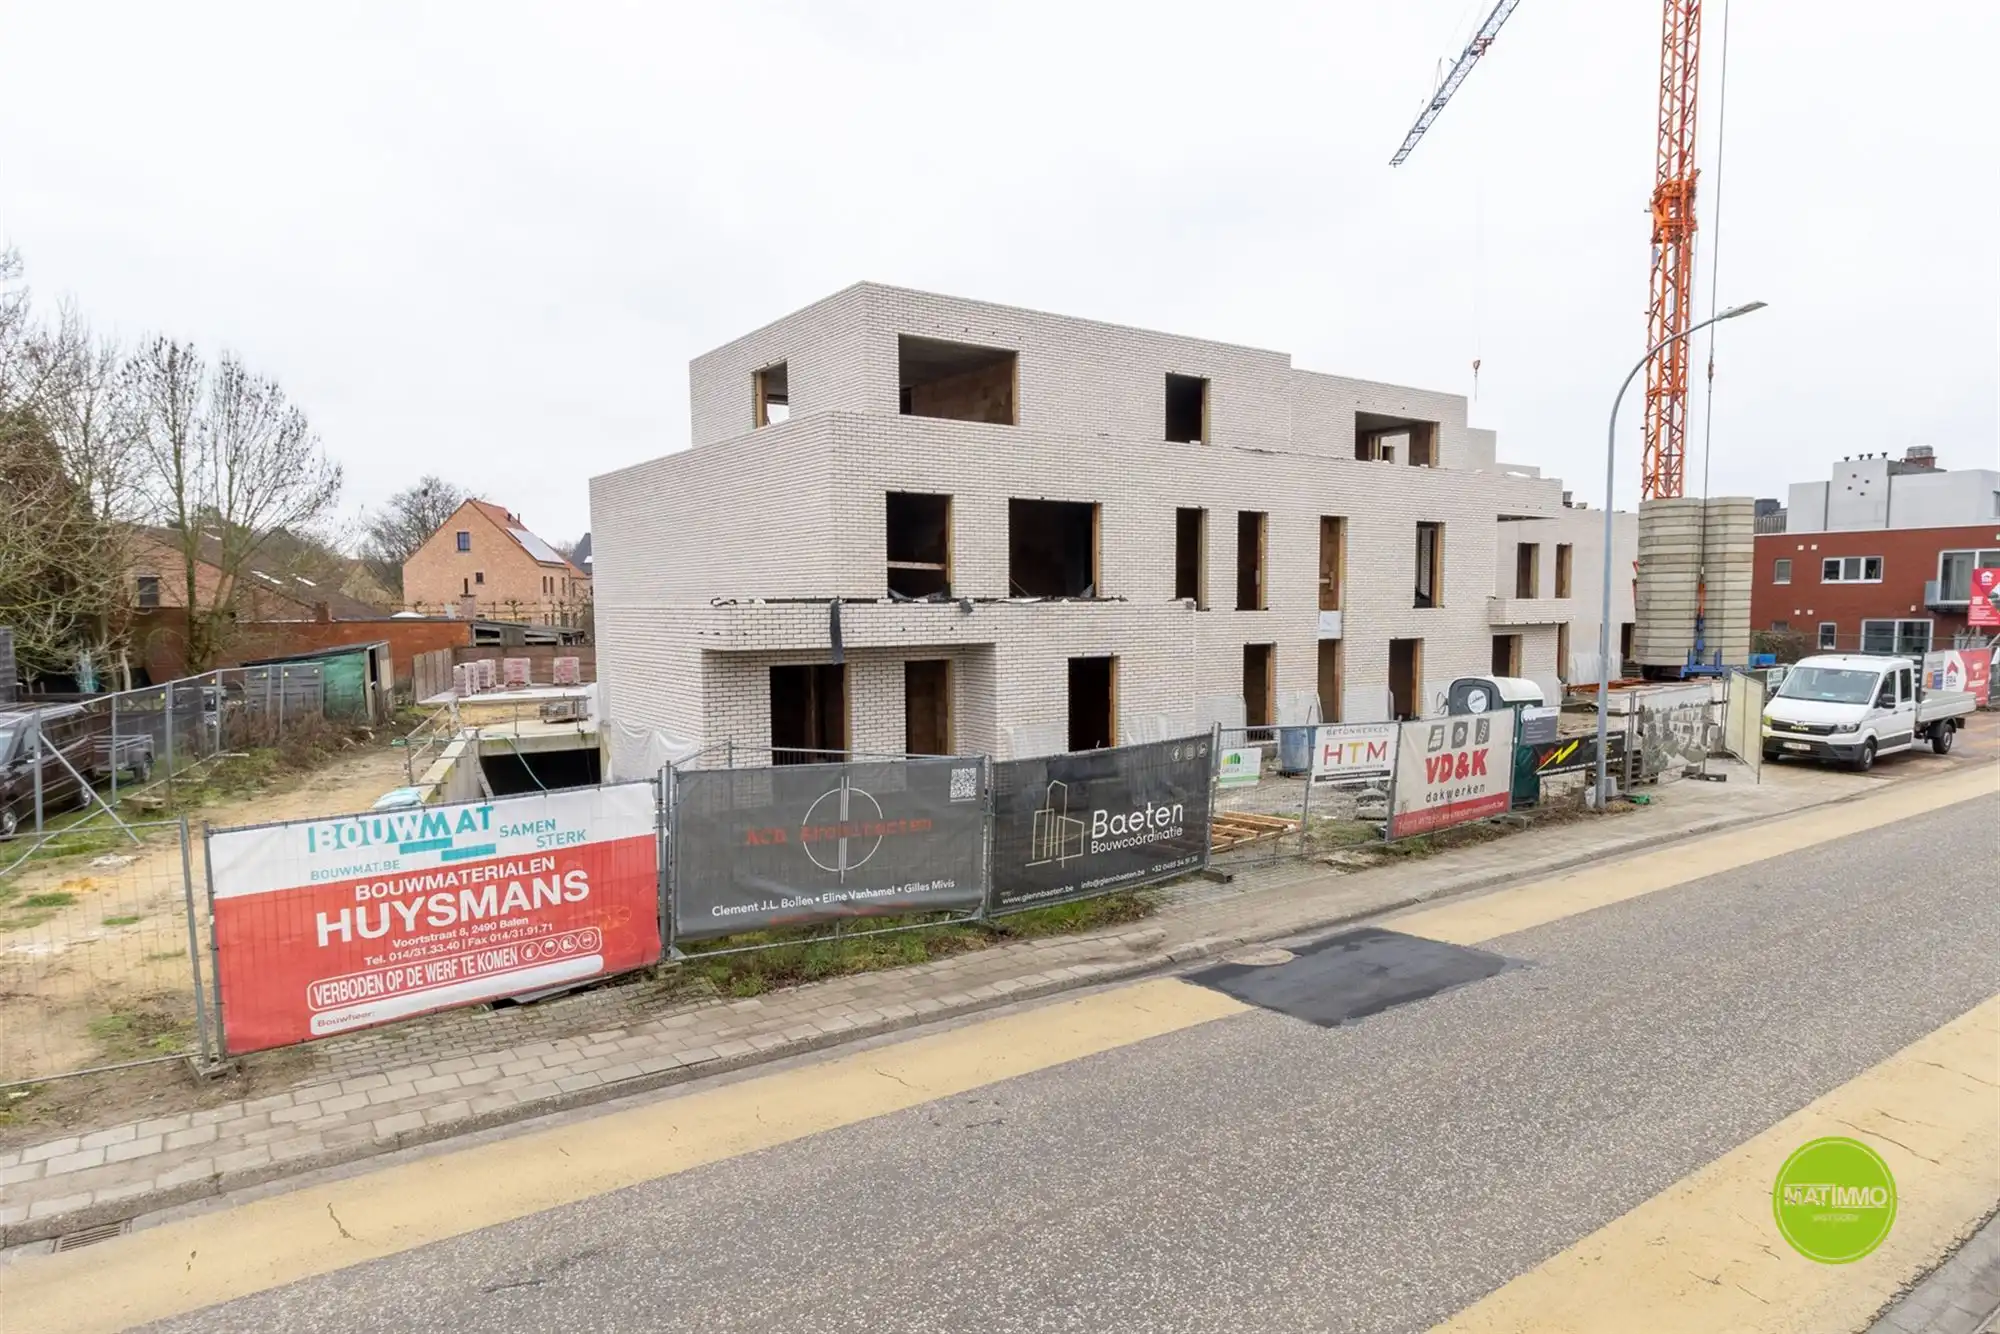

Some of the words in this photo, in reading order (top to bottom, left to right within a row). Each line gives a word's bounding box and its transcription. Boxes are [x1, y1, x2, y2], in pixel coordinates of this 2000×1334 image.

[1324, 741, 1388, 766] HTM
[1425, 748, 1489, 785] VD&K
[1425, 783, 1485, 803] dakwerken
[308, 805, 494, 853] BOUWMAT
[500, 818, 556, 838] SAMEN
[536, 829, 586, 848] STERK
[1092, 802, 1183, 839] Baeten
[1091, 826, 1183, 854] Bouwcoördinatie
[311, 859, 401, 881] BOUWMAT.BE
[355, 856, 556, 901] BOUWMATERIALEN
[316, 869, 590, 947] HUYSMANS
[712, 902, 759, 917] Clement
[761, 900, 779, 911] J.L.
[781, 896, 814, 908] Bollen
[822, 892, 848, 903] Eline
[848, 884, 895, 900] Vanhamel
[904, 882, 930, 893] Gilles
[931, 879, 955, 889] Mivis
[364, 954, 386, 966] Tel.
[389, 940, 460, 962] 014/31.33.40
[468, 937, 488, 947] Fax
[490, 923, 553, 943] 014/31.91.71
[392, 930, 457, 949] Voortstraat
[471, 922, 497, 935] 2490
[499, 917, 529, 928] Balen
[313, 972, 384, 1006] VERBODEN
[386, 969, 404, 992] OP
[406, 965, 423, 988] DE
[425, 959, 459, 983] WERF
[461, 953, 476, 975] TE
[478, 946, 518, 972] KOMEN
